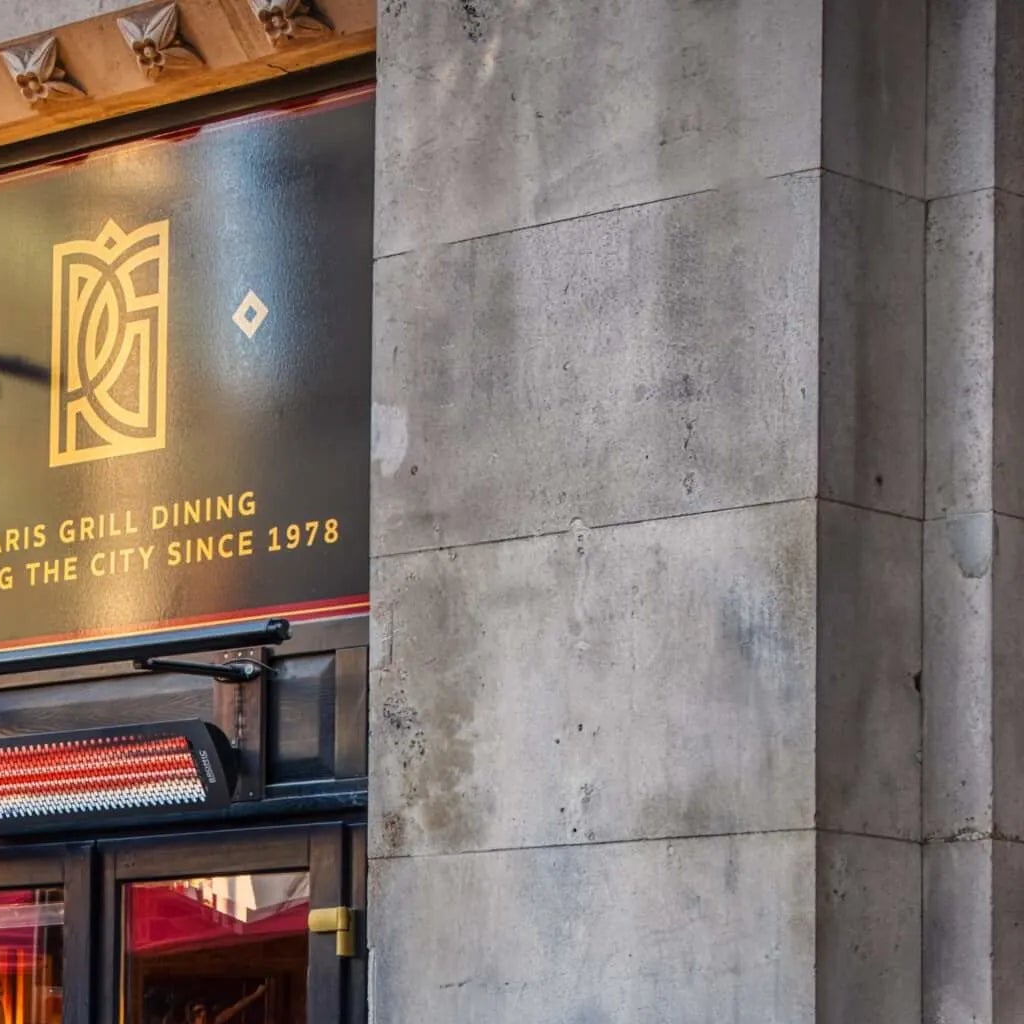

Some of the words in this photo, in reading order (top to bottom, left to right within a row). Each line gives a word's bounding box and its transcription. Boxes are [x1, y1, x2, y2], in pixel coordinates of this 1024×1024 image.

[59, 510, 137, 544] GRILL
[151, 491, 256, 530] DINING
[26, 557, 77, 586] THE
[90, 545, 155, 577] CITY
[168, 531, 253, 566] SINCE
[268, 518, 339, 552] 1978
